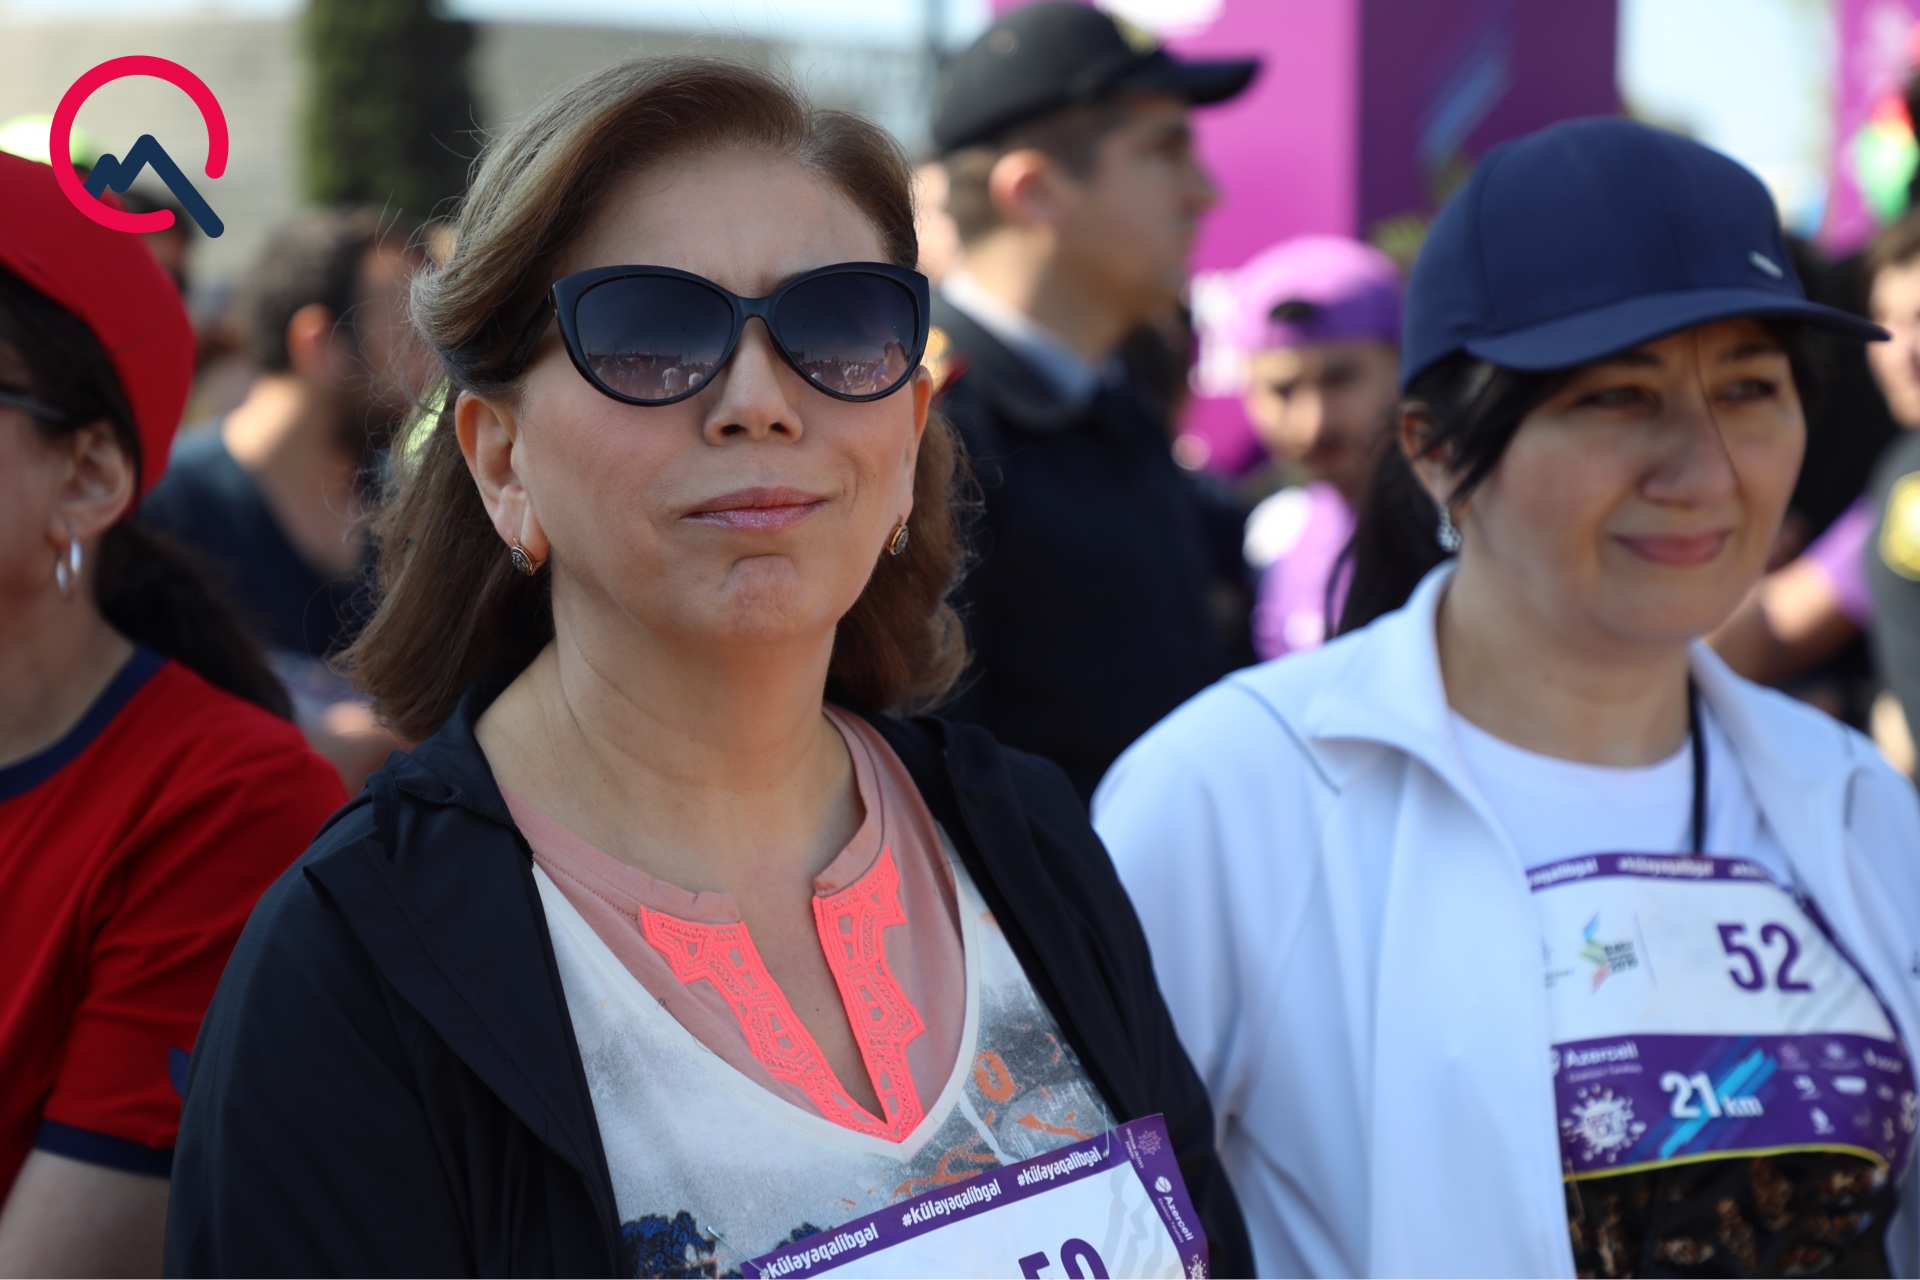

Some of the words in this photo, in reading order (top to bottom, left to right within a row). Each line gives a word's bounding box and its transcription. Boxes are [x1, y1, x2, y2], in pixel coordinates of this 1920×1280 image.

[1715, 921, 1815, 992] 52
[902, 1178, 1001, 1227] #küləyəqalibgəl
[1017, 1146, 1102, 1187] #küləyəqalibgəl
[1163, 1195, 1194, 1241] Azercell
